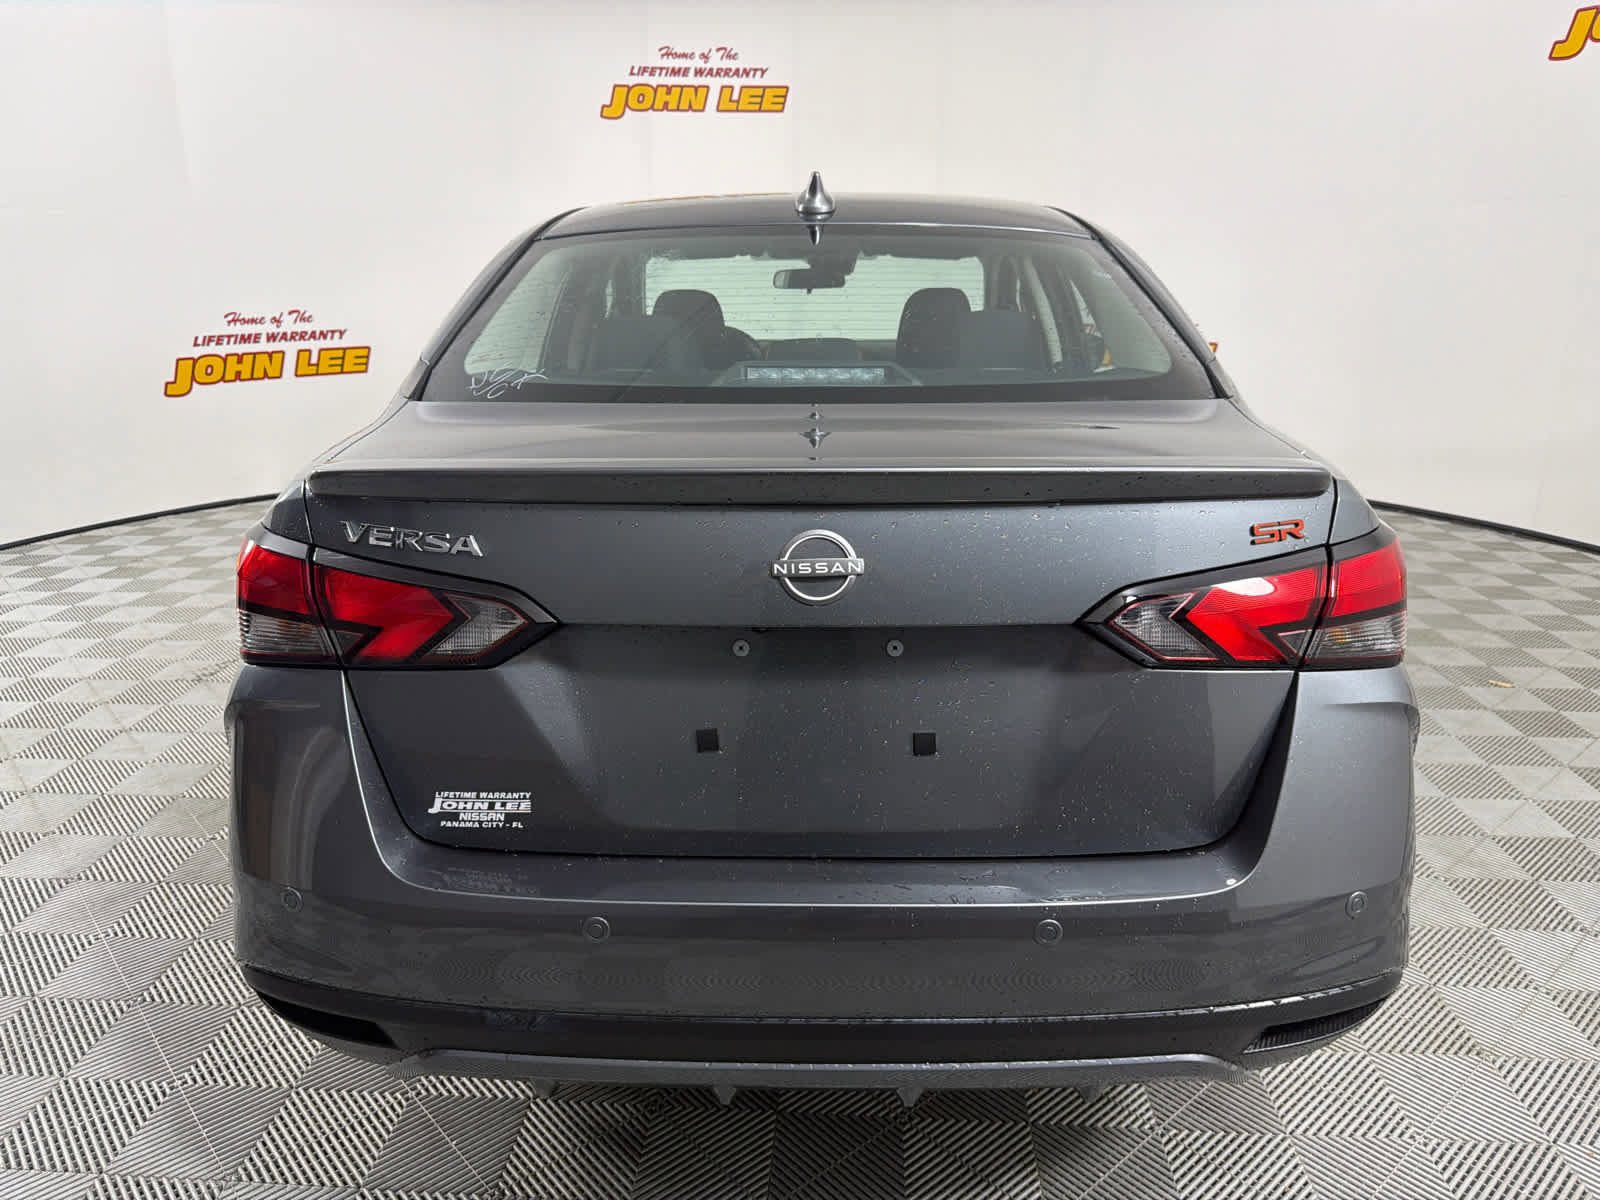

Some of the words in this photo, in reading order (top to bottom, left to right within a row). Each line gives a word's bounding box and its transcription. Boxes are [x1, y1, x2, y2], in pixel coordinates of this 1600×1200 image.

[658, 46, 695, 60] Home
[699, 48, 712, 64] of
[715, 46, 739, 61] The
[629, 65, 690, 77] LIFETIME
[694, 67, 768, 79] WARRANTY
[600, 83, 710, 120] JOHN
[716, 86, 789, 112] LEE
[223, 311, 265, 326] Home
[270, 312, 283, 327] of
[288, 309, 313, 324] The
[193, 332, 262, 347] LIFETIME
[265, 329, 347, 344] WARRANTY
[164, 350, 285, 398] JOHN
[294, 346, 371, 377] LEE
[339, 520, 483, 557] VERSA
[1249, 519, 1304, 545] SR
[773, 561, 861, 574] NISSAN
[427, 798, 489, 814] JOHN
[494, 802, 532, 810] LEE
[459, 813, 505, 821] NISSAN
